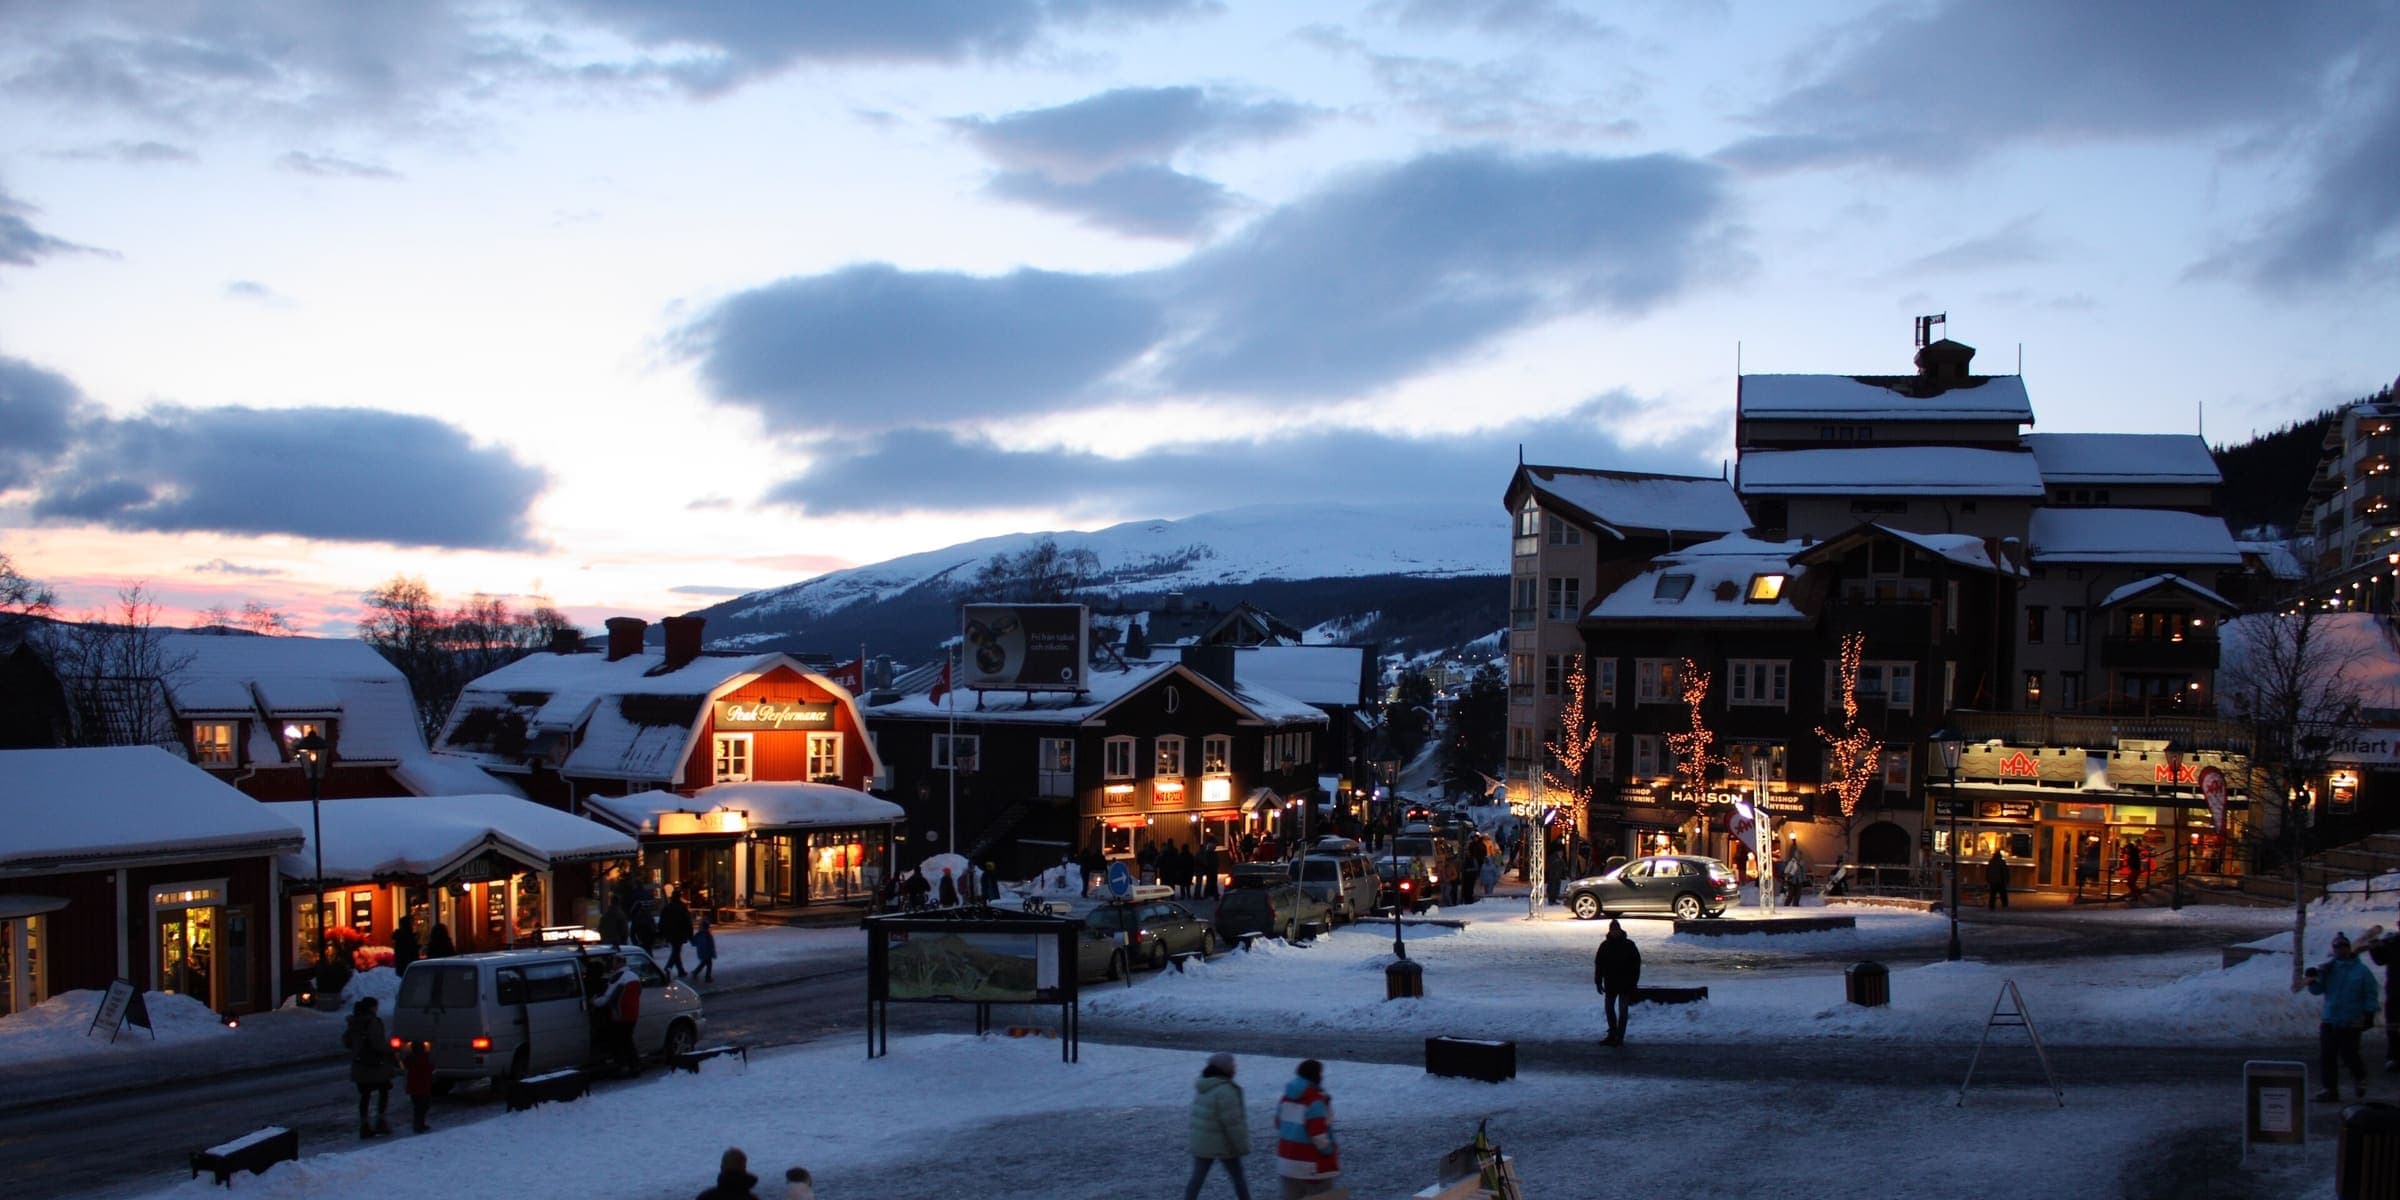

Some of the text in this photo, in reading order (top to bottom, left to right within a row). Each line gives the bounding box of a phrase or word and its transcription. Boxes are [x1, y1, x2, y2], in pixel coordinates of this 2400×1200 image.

[726, 704, 828, 728] Peak Performance
[1999, 751, 2040, 777] MAX
[1671, 791, 1743, 804] HANSON
[1768, 795, 1799, 803] KISHOP
